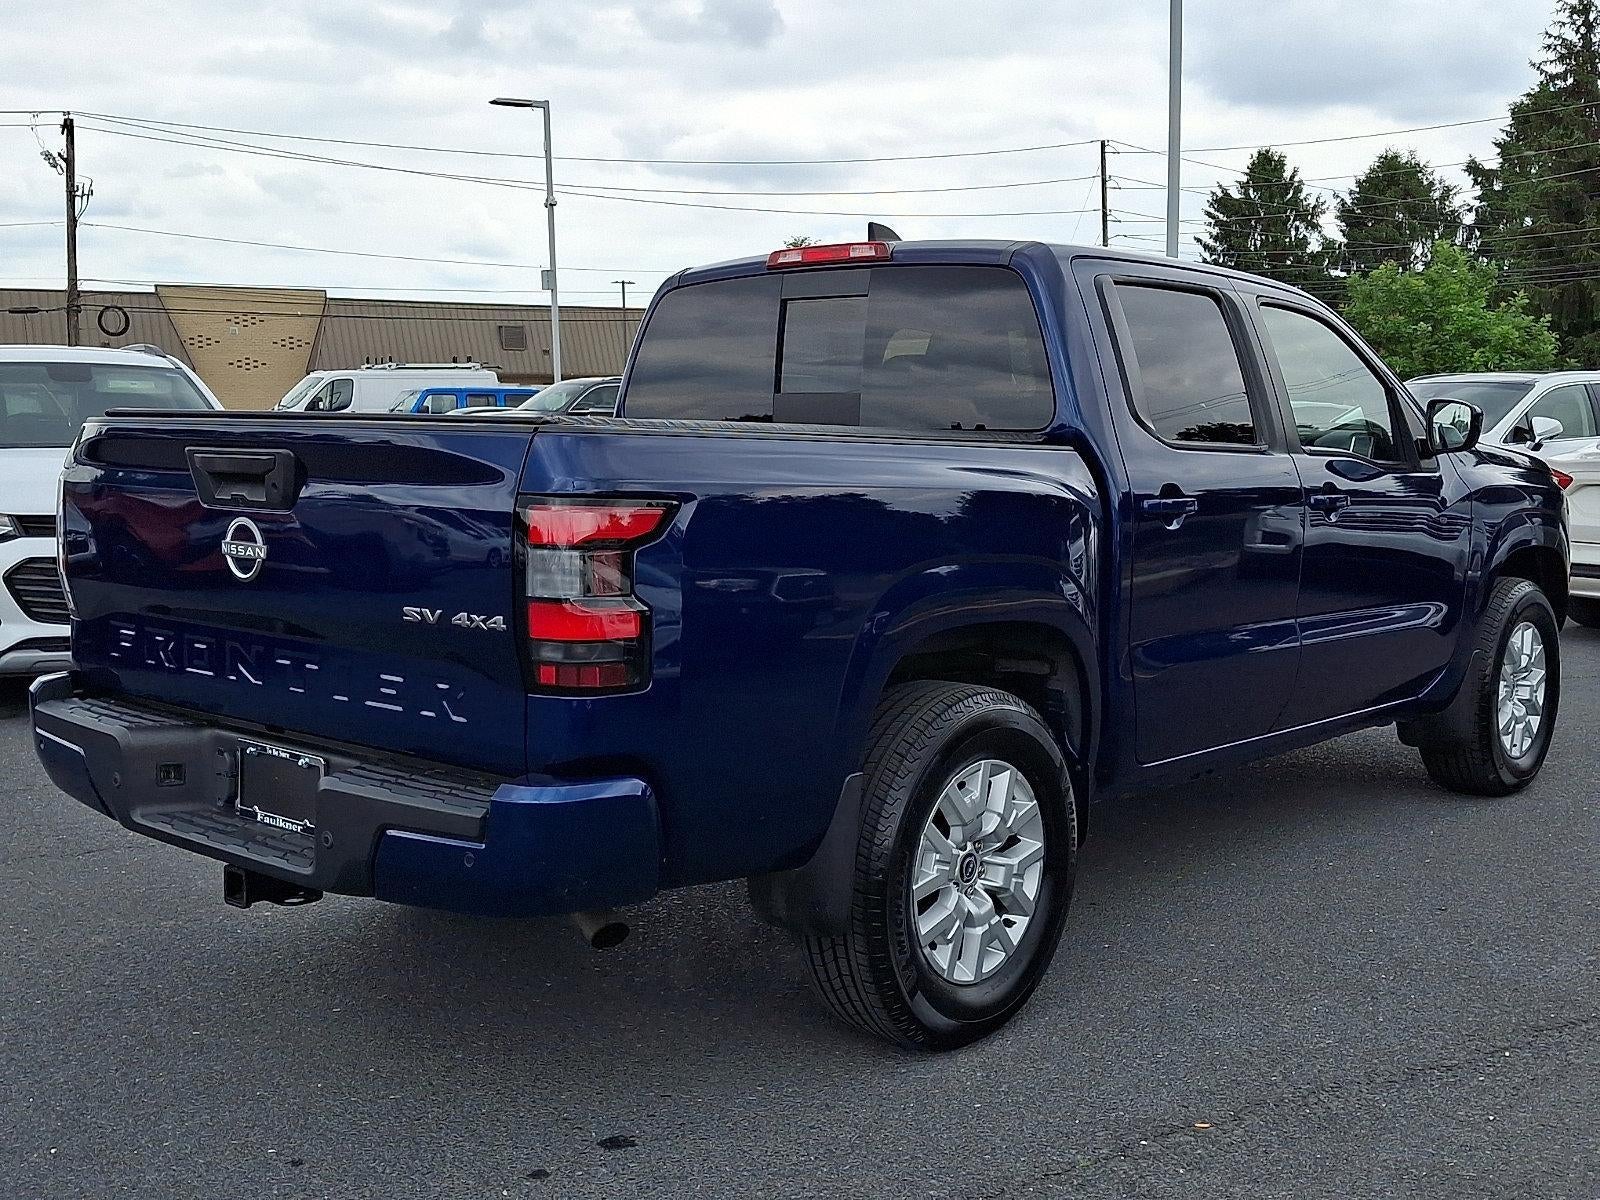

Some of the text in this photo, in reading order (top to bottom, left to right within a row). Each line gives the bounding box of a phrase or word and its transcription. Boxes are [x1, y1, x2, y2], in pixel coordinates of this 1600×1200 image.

[222, 542, 266, 558] NISSAN
[402, 605, 443, 625] SV
[109, 620, 468, 724] FRONTER
[256, 811, 304, 833] Faulkner
